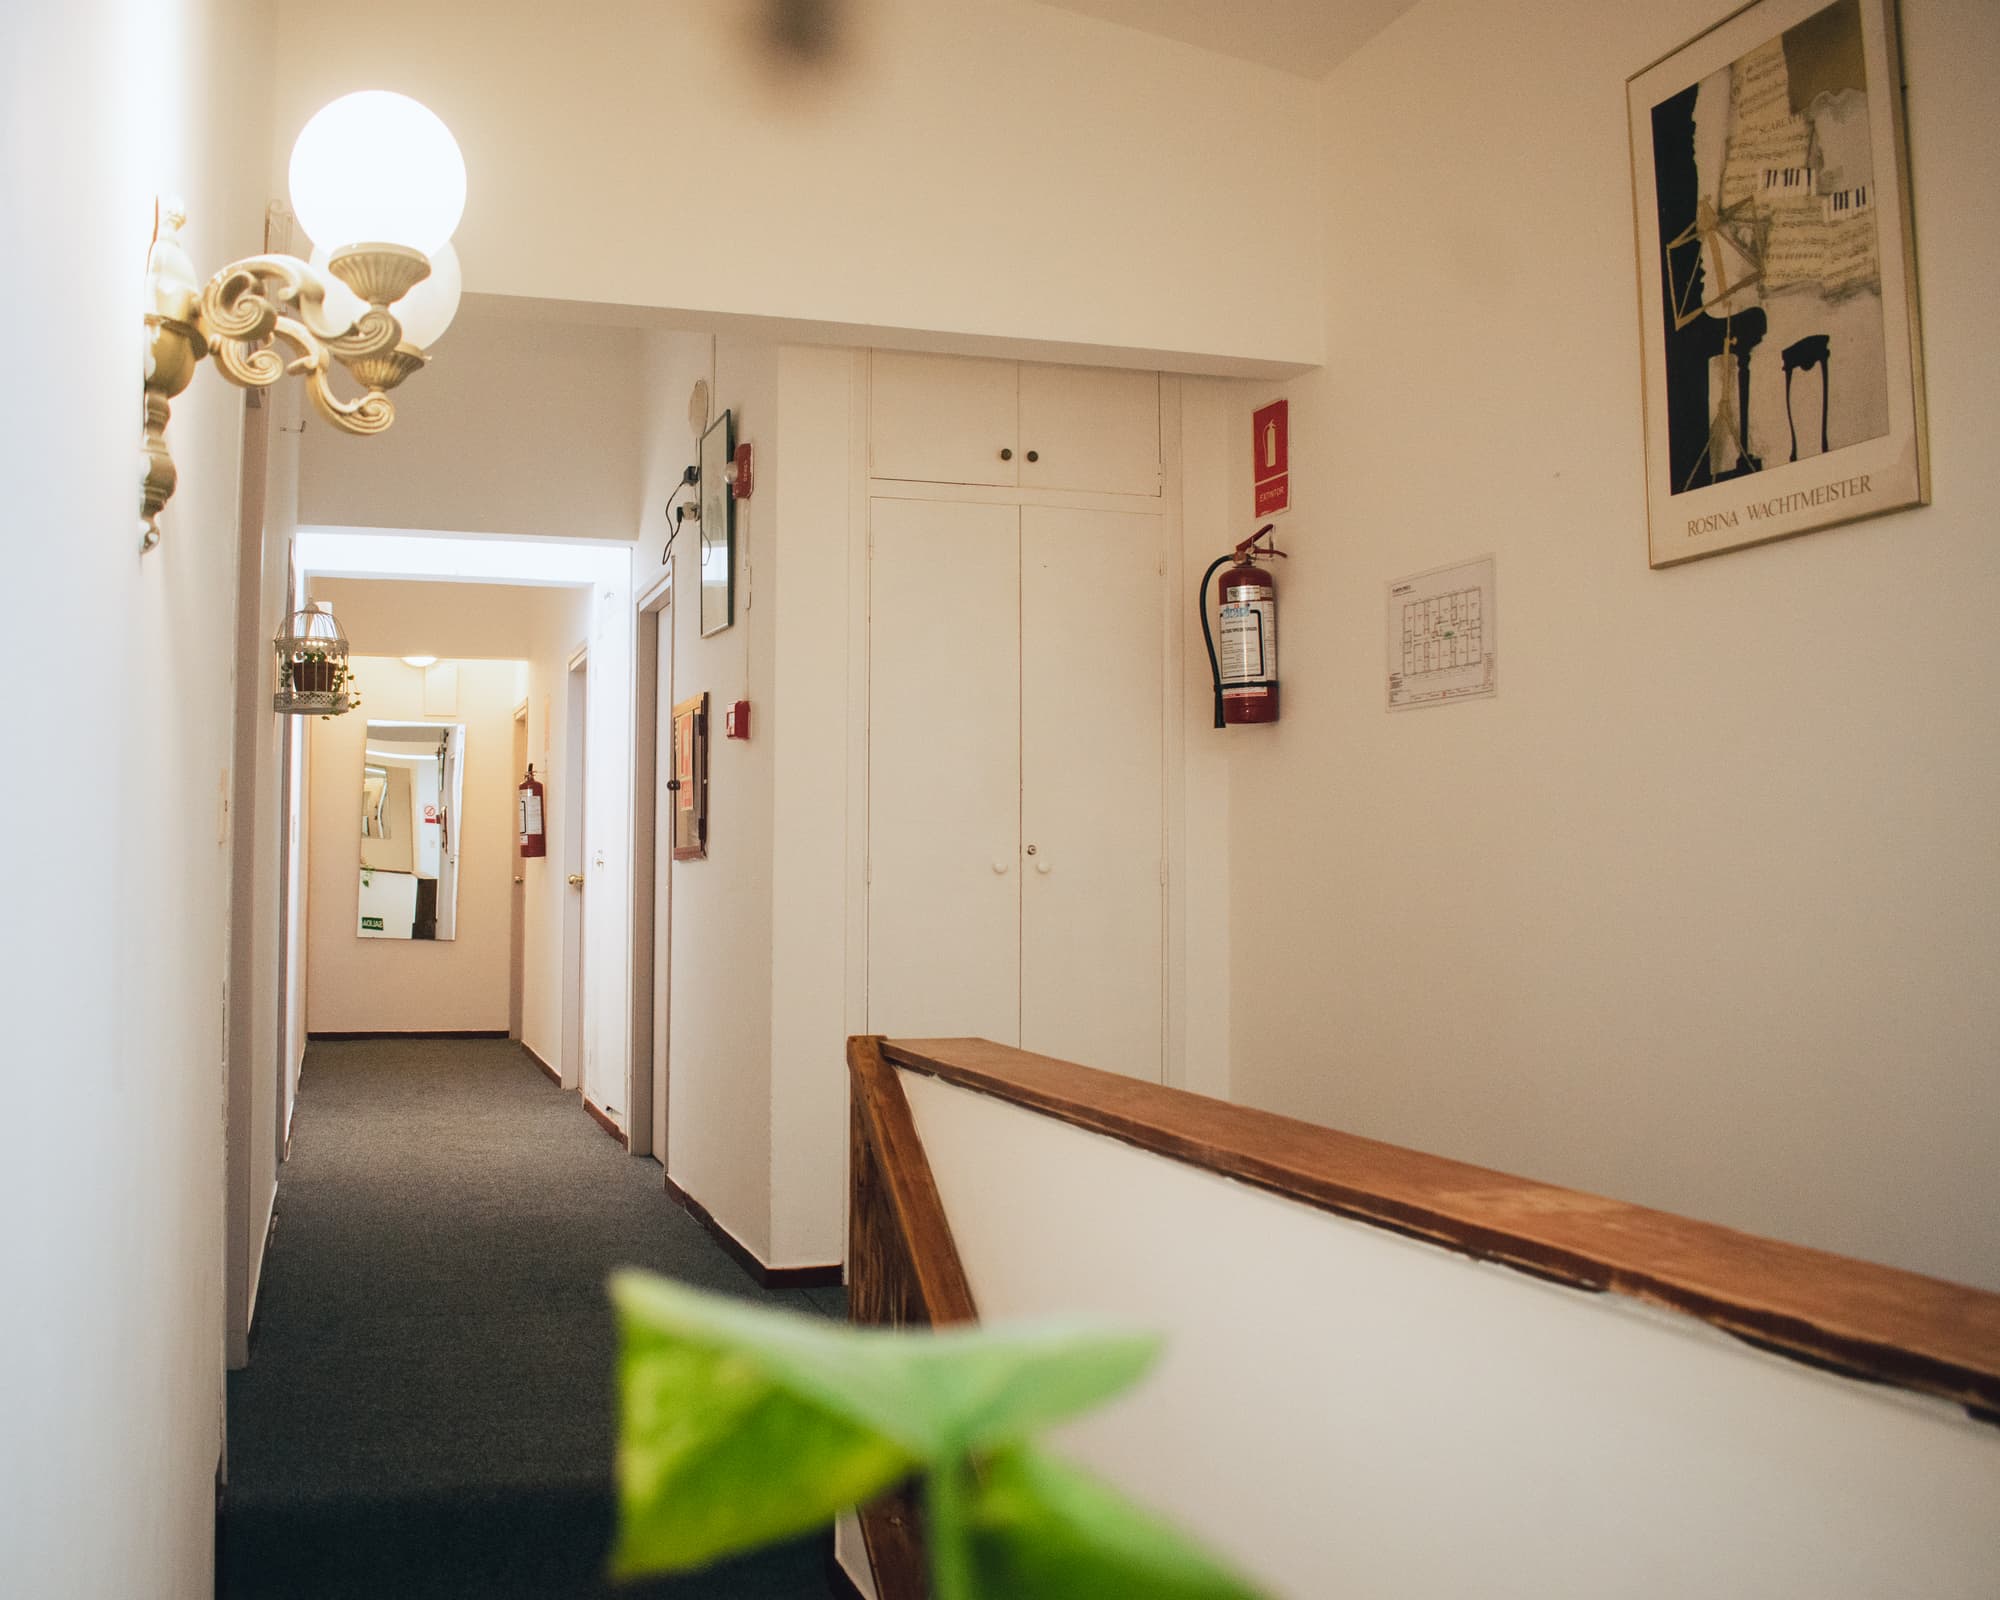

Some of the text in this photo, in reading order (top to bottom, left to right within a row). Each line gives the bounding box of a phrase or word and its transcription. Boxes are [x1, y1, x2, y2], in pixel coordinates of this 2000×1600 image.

[1259, 486, 1284, 502] EXTINTOR
[1687, 474, 1872, 537] ROSINA WACHTMEISTER
